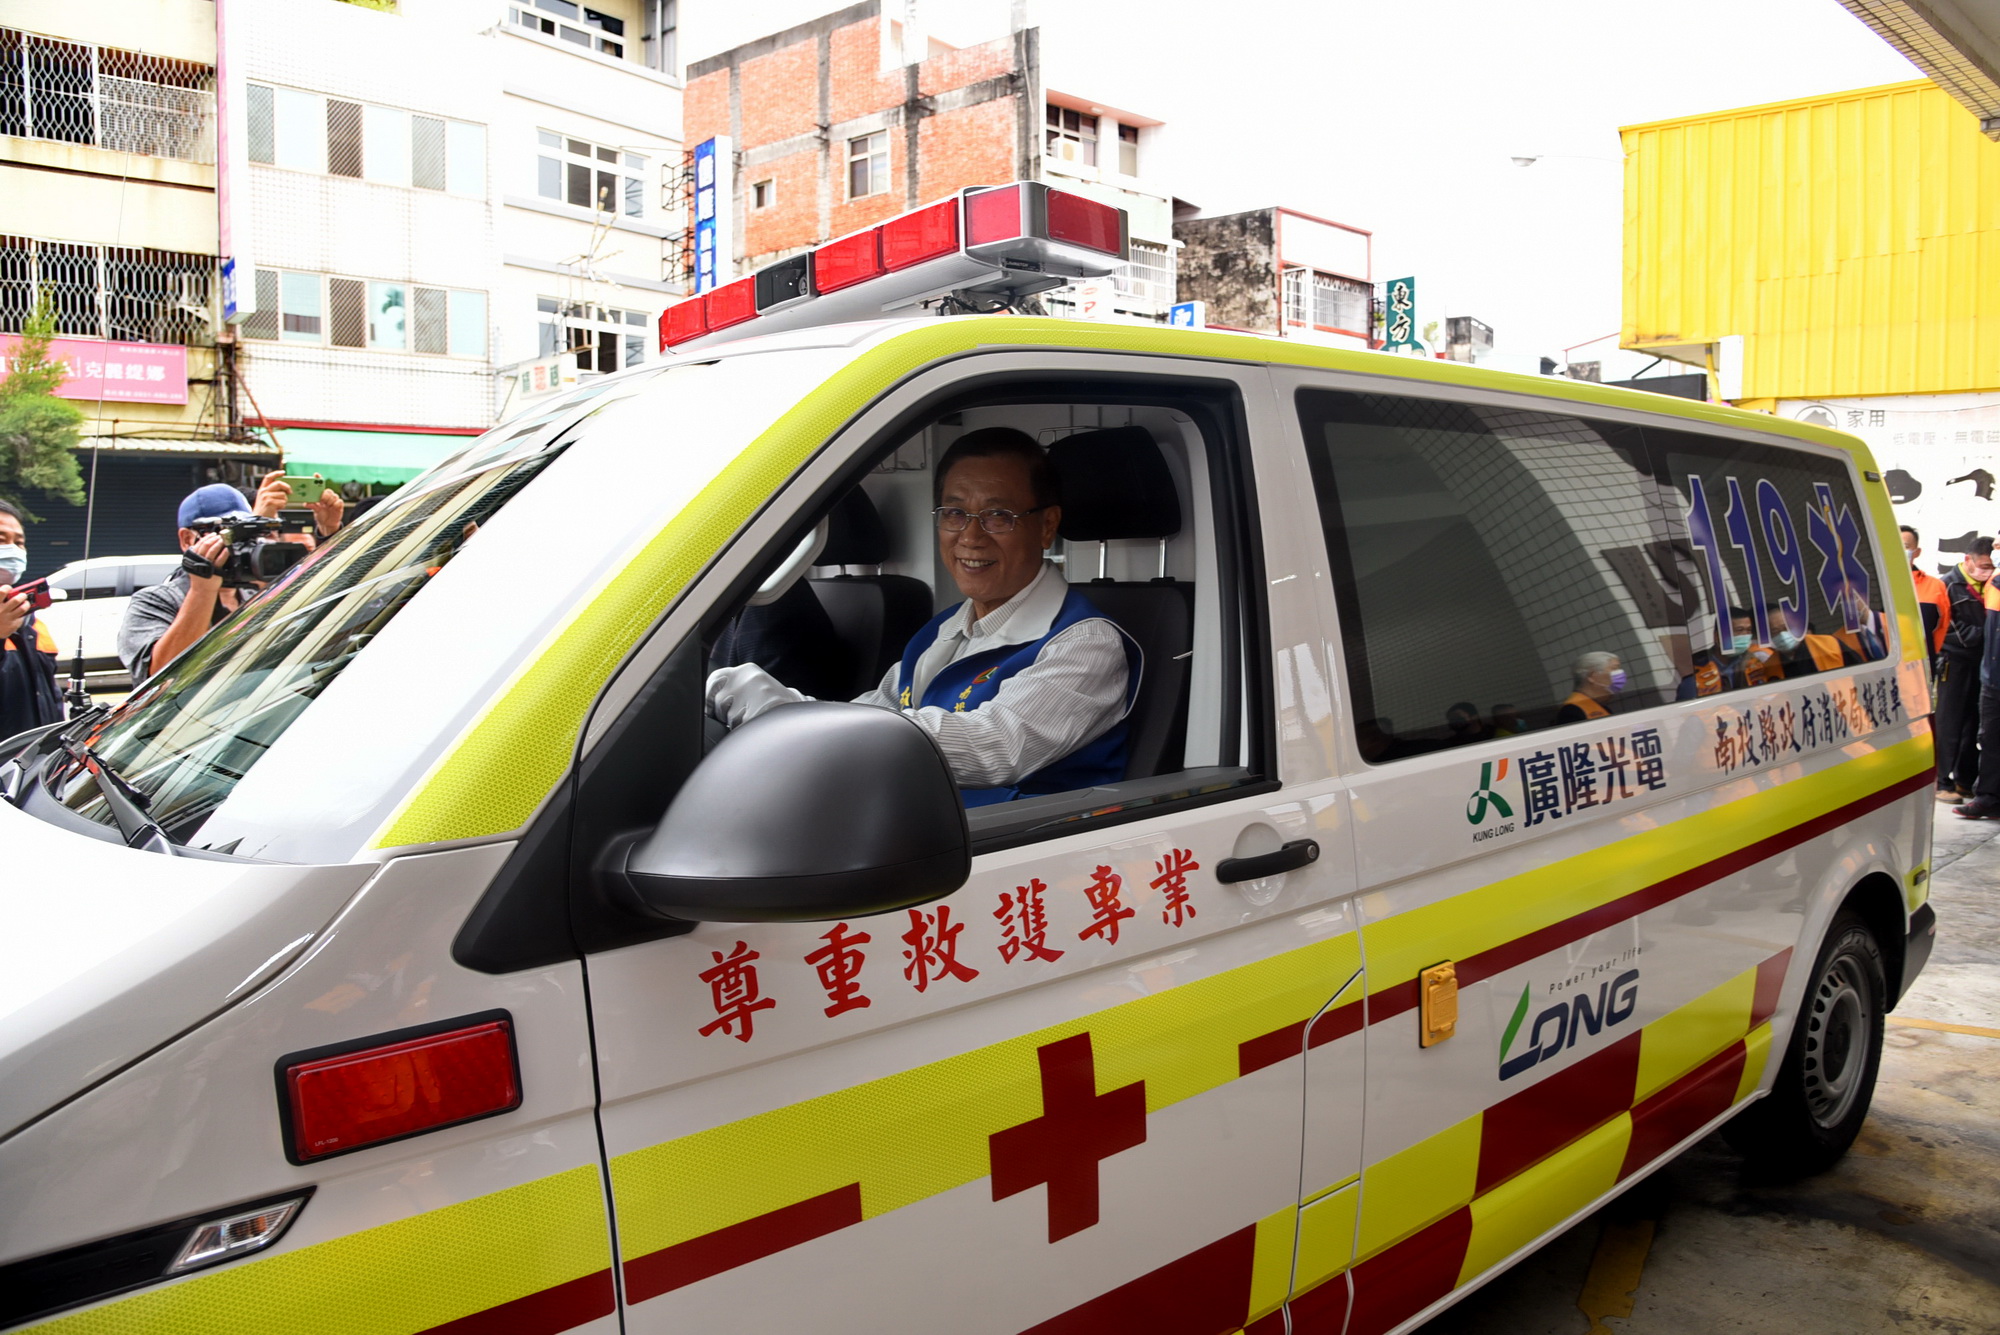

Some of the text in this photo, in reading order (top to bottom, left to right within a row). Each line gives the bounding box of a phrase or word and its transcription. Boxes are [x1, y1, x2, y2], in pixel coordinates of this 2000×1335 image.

[1390, 282, 1413, 342] 東方
[1847, 410, 1885, 428] 家用
[1686, 474, 1810, 656] 119
[1713, 676, 1902, 776] 南投縣政府消防局救護車
[1518, 728, 1667, 828] 廣隆光電
[1472, 822, 1515, 843] KUNG LONG
[698, 848, 1200, 1043] 尊重救護專業
[1549, 947, 1643, 995] Power your life
[1499, 968, 1640, 1081] LONG
